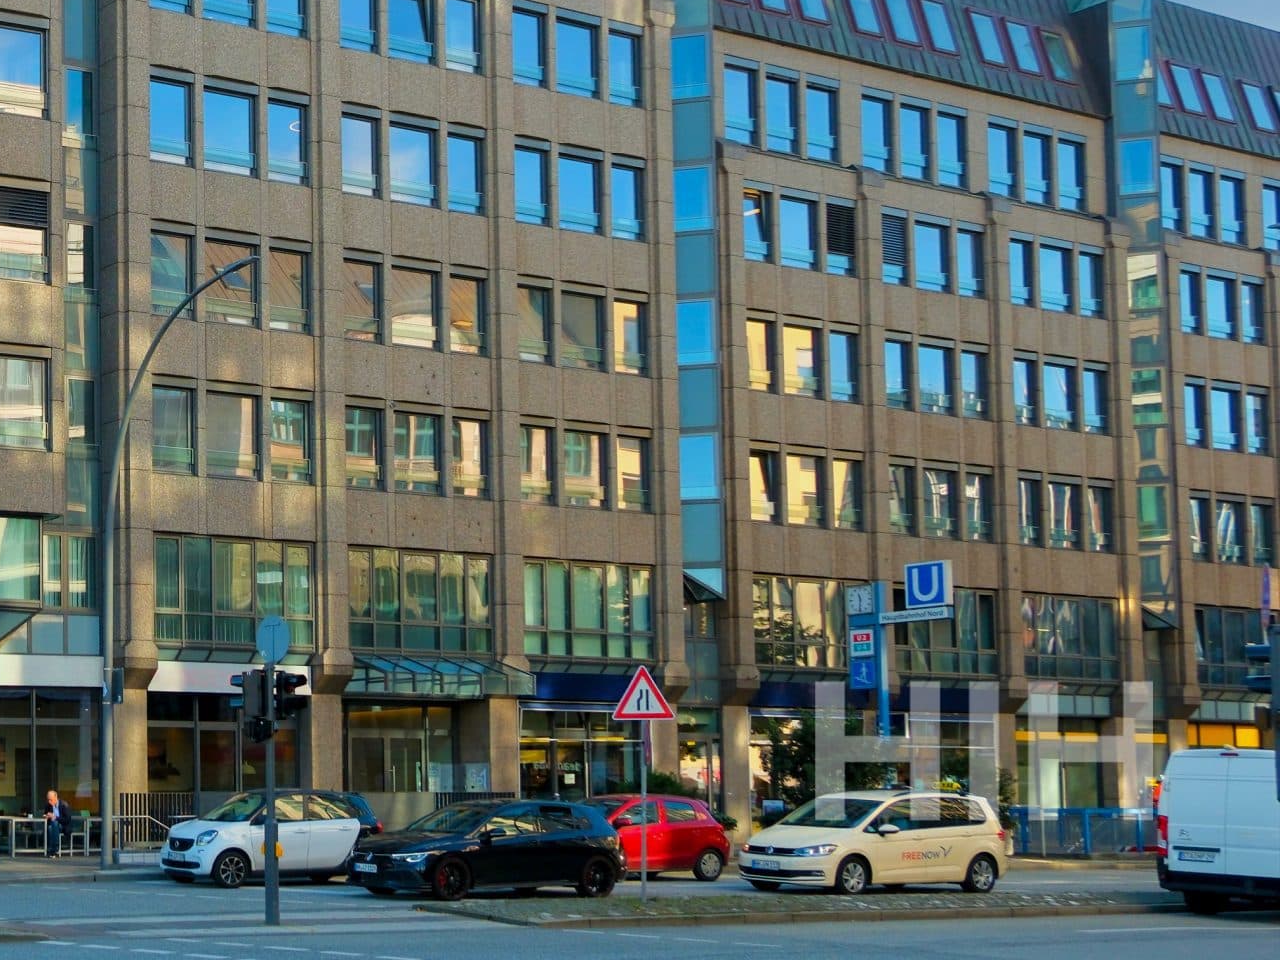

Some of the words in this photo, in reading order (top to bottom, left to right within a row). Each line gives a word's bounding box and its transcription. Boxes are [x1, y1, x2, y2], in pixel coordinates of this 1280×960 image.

[911, 566, 939, 602] U
[881, 611, 927, 622] Hauptbahnhof
[927, 609, 944, 617] Nord
[902, 850, 940, 861] FREENOW
